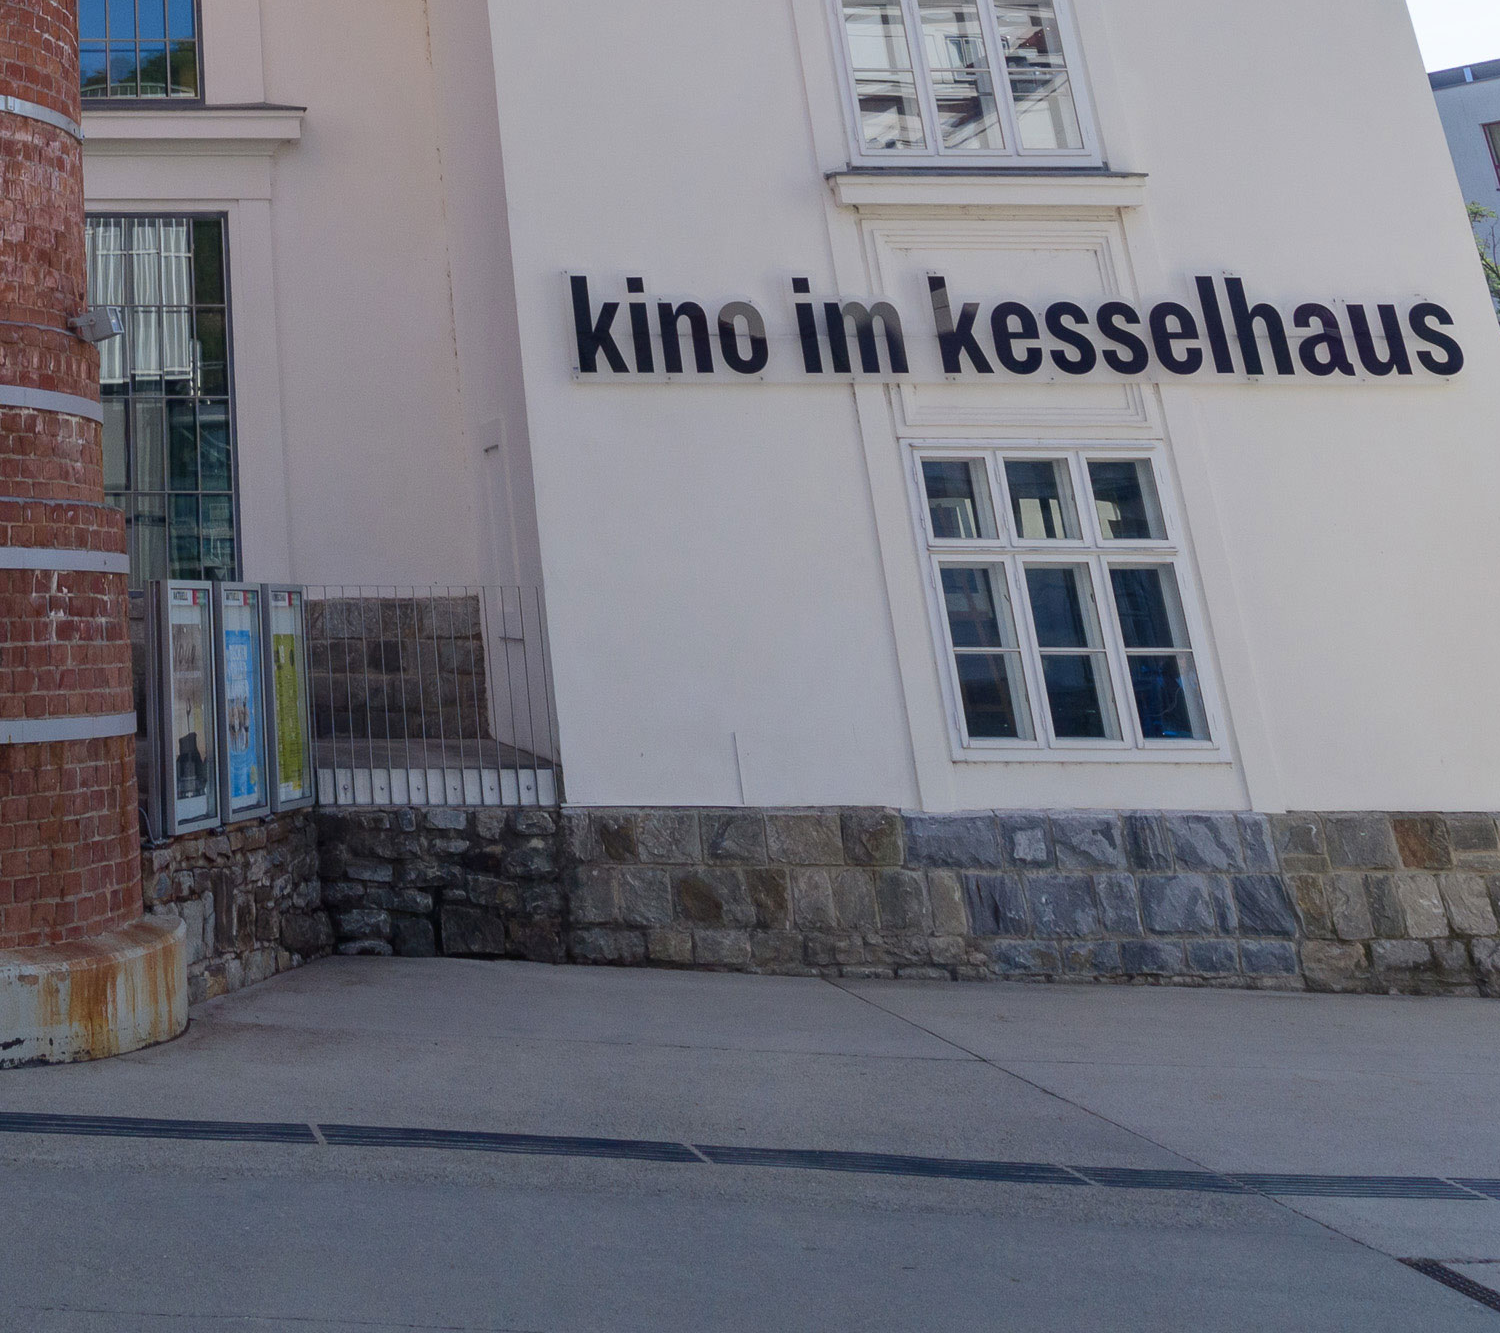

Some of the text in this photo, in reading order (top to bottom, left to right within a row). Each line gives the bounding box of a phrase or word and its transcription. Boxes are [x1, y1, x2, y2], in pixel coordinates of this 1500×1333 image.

[570, 274, 1465, 377] kino im kesselhaus
